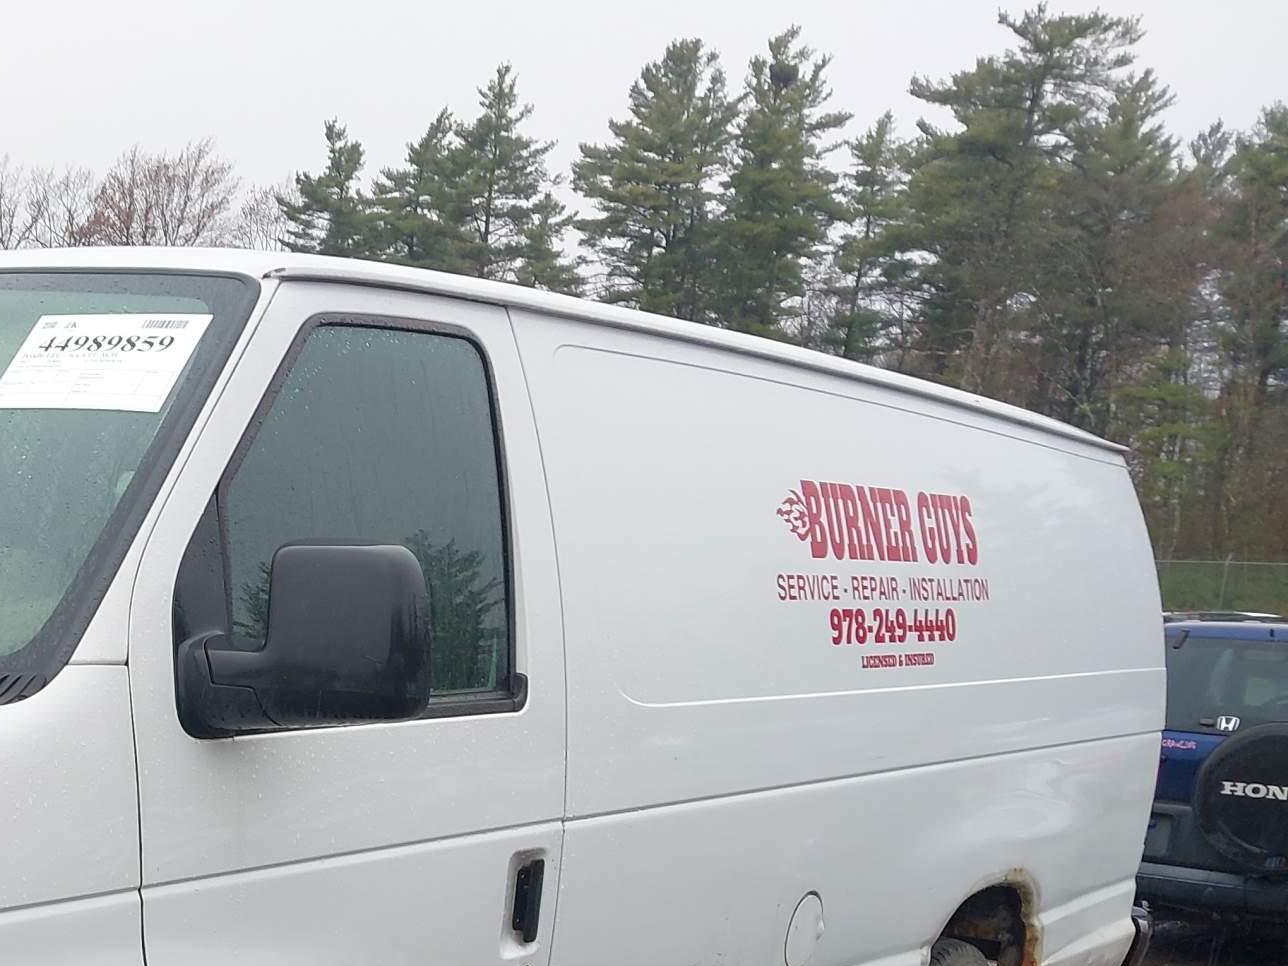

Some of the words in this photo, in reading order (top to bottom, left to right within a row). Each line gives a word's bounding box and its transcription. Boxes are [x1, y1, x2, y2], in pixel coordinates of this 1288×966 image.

[38, 335, 175, 352] 44989859
[800, 480, 918, 562] BURNER
[917, 492, 978, 565] GUYS
[776, 574, 840, 601] SERVICE
[851, 576, 899, 601] REPAIR
[909, 577, 990, 601] INSTALLATION
[830, 608, 956, 645] 978-249-4440
